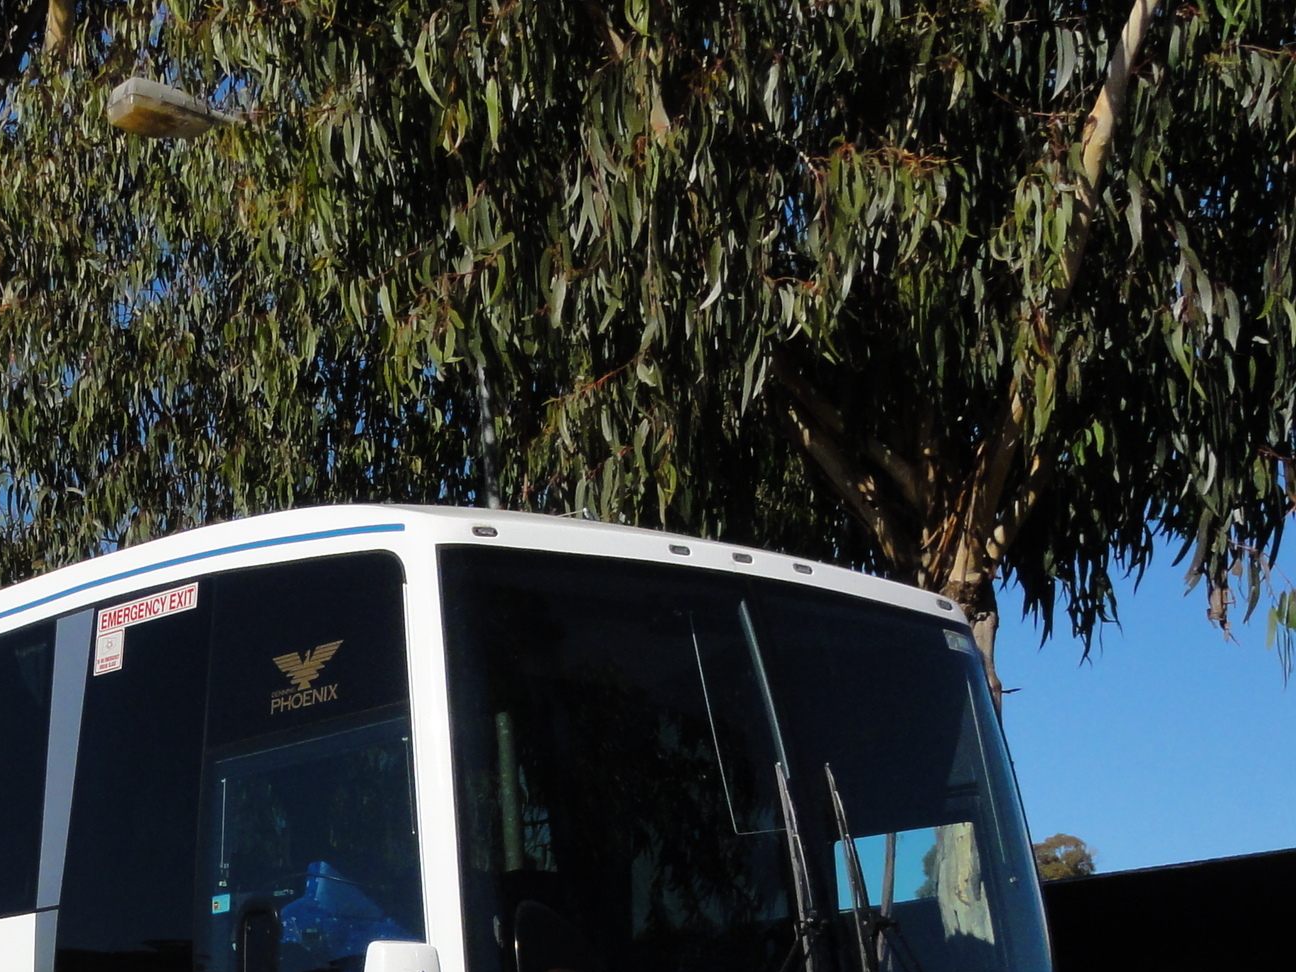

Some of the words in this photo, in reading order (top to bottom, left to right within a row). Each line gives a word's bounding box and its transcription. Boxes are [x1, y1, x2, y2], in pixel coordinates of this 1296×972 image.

[101, 596, 167, 629] EMERGENCY
[169, 589, 194, 610] EXIT
[270, 683, 338, 715] PHOENIX
